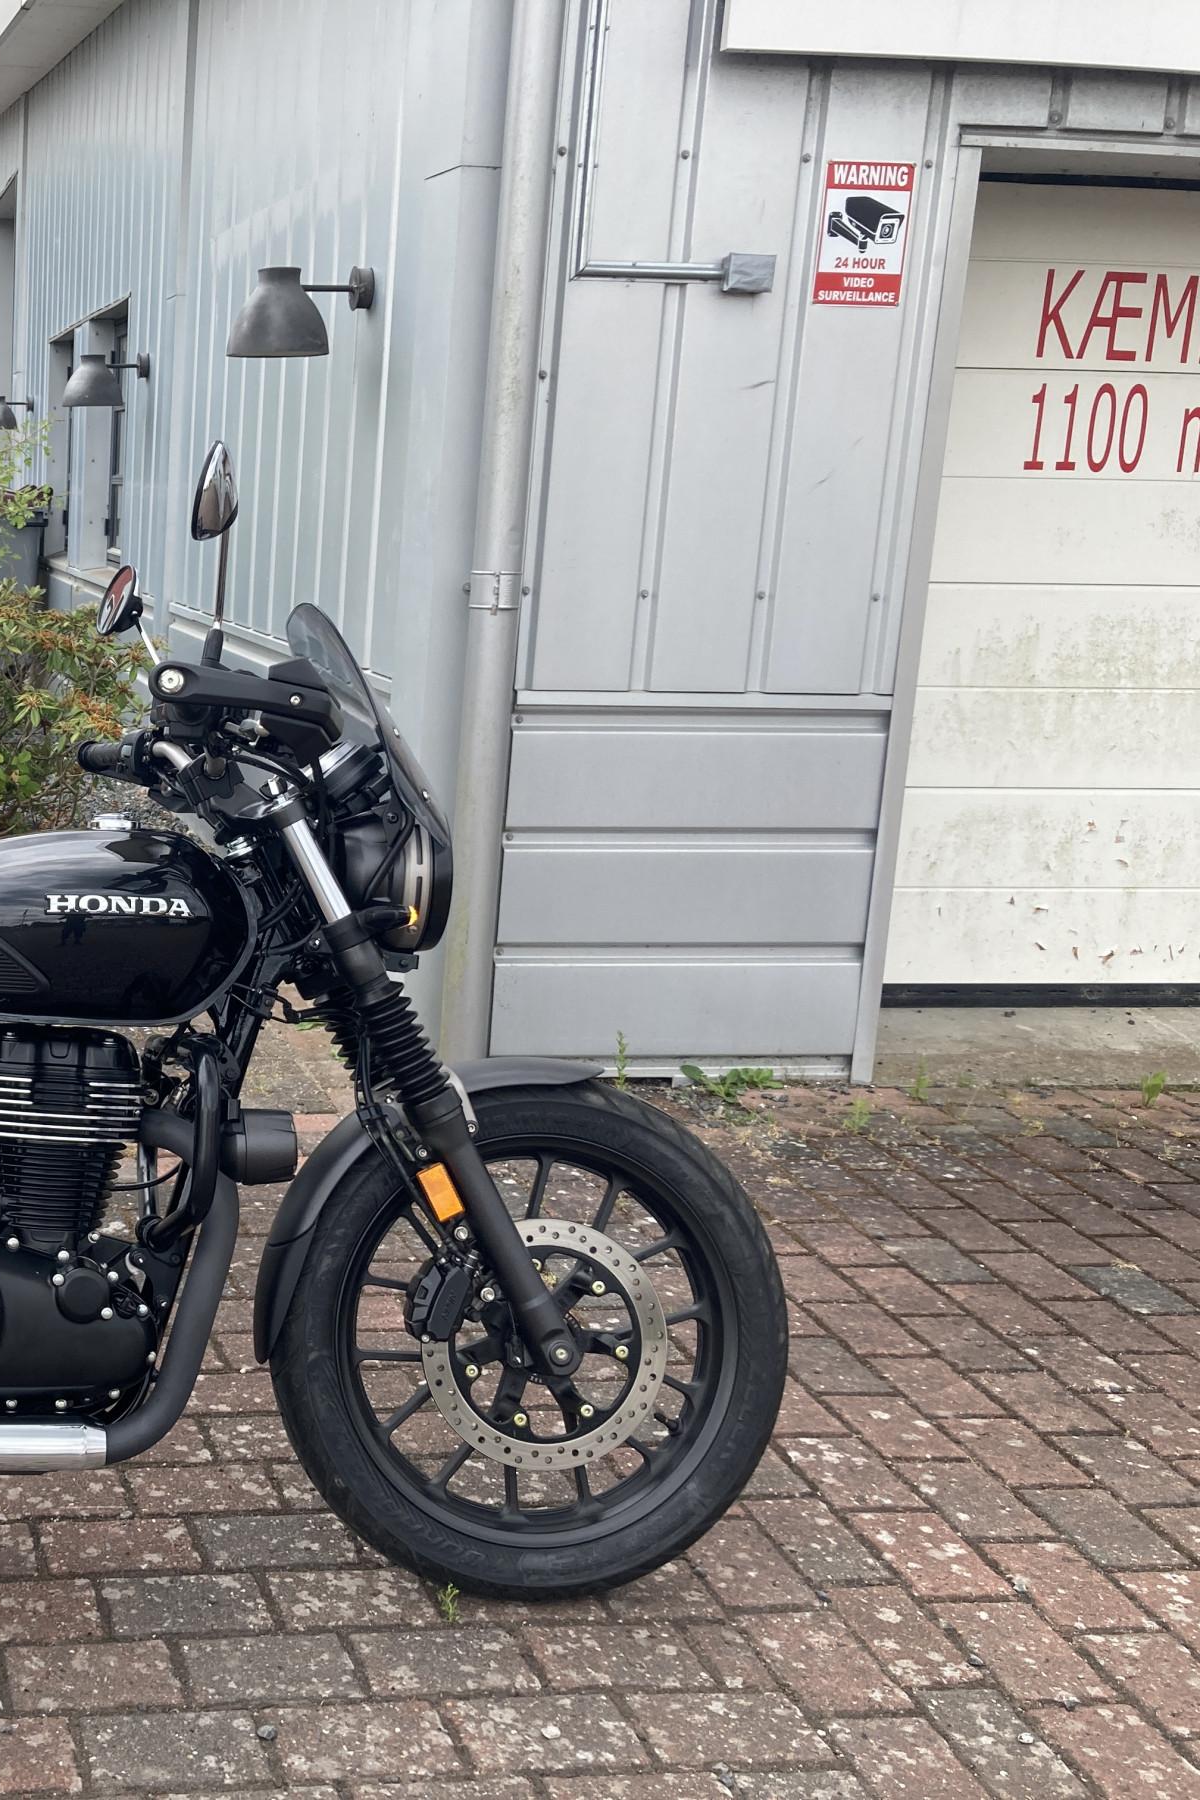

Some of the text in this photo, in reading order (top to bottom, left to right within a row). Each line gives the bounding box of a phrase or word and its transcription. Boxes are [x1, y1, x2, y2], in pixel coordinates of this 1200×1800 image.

[833, 164, 908, 186] WARNING
[834, 257, 886, 270] 24 HOUR
[843, 277, 874, 288] VIDEO
[817, 290, 895, 303] SURVEILLANCE
[1036, 268, 1200, 364] KÆM
[1023, 383, 1148, 473] 1100
[46, 894, 193, 917] HONDA
